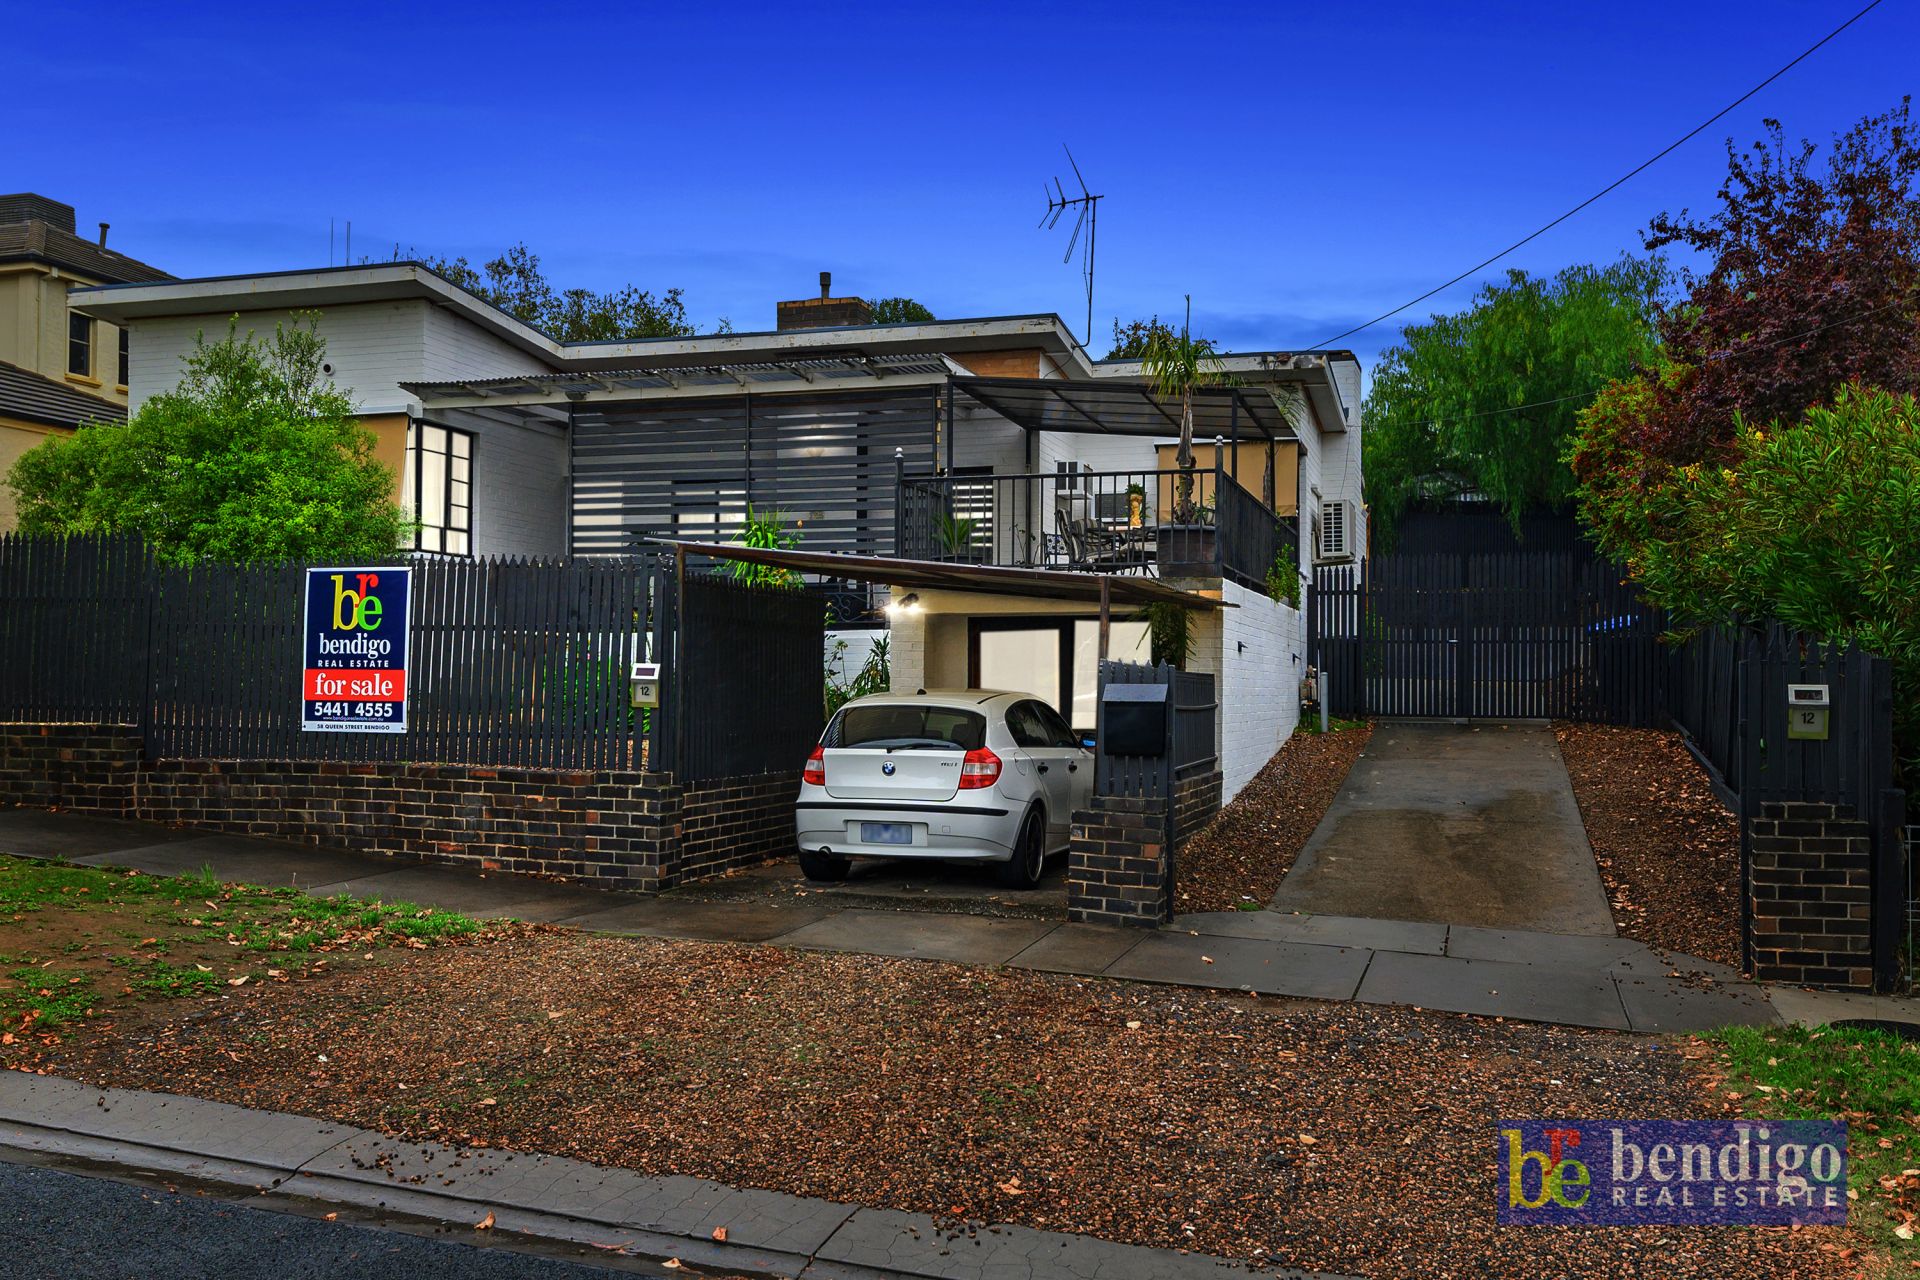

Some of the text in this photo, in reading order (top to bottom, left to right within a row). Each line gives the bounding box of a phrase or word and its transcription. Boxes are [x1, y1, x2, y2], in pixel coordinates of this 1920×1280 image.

[319, 632, 391, 659] bendigo
[317, 659, 390, 668] REAL ESTATE
[314, 672, 393, 696] for sale
[639, 685, 650, 696] 12
[314, 701, 393, 718] 5441 4555
[1800, 711, 1816, 725] 12
